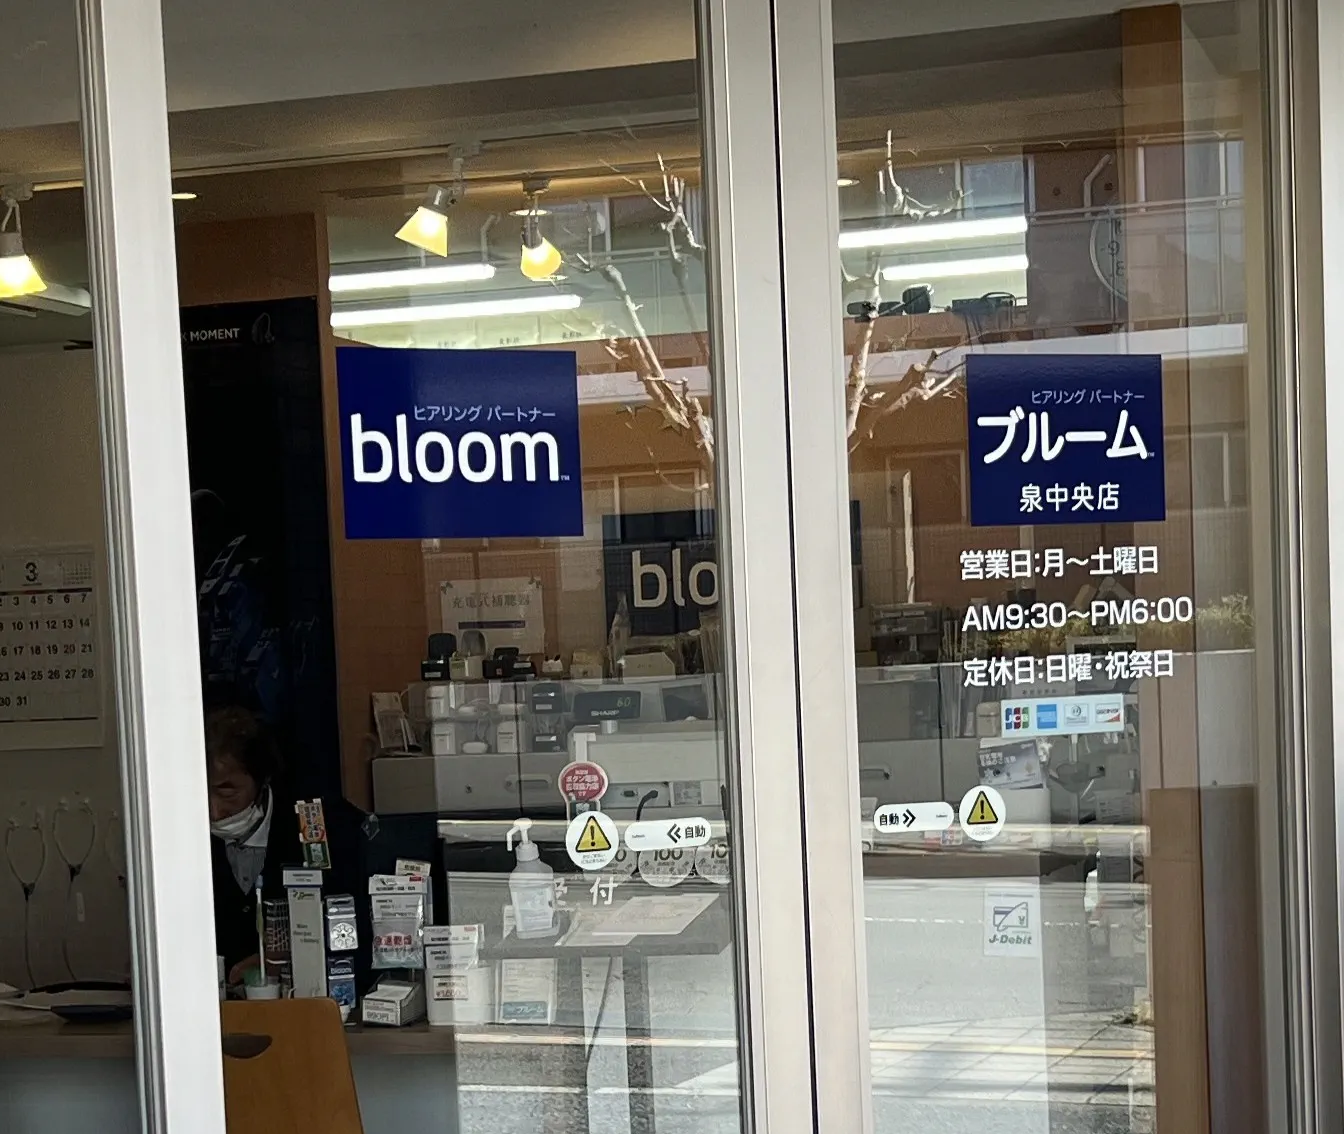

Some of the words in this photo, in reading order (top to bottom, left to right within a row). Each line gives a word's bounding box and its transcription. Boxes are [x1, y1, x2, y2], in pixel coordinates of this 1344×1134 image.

[1031, 389, 1086, 404] ヒアリング
[1089, 390, 1145, 404] パートナー
[414, 405, 482, 422] ヒアリング
[487, 407, 556, 422] パートナー
[977, 405, 1148, 464] ブルーム
[351, 413, 560, 483] bloom
[1019, 482, 1120, 513] 泉中央店
[25, 562, 39, 582] 3
[962, 597, 1193, 632] AM9:30〜PM6:00
[12, 622, 23, 631] 10
[29, 621, 40, 630] 11
[46, 620, 57, 630] 12
[62, 619, 73, 629] 13
[79, 618, 90, 628] 14
[14, 646, 24, 656] 17
[30, 646, 41, 655] 18
[47, 645, 58, 655] 19
[63, 644, 75, 654] 20
[81, 644, 92, 653] 21
[14, 672, 26, 681] 24
[31, 671, 43, 680] 25
[48, 670, 60, 680] 26
[65, 669, 76, 679] 27
[81, 669, 94, 678] 28
[16, 696, 28, 706] 31
[591, 709, 620, 717] SHARP
[879, 813, 900, 827] 自動
[684, 825, 706, 839] 自動
[989, 934, 1032, 945] J-Debit
